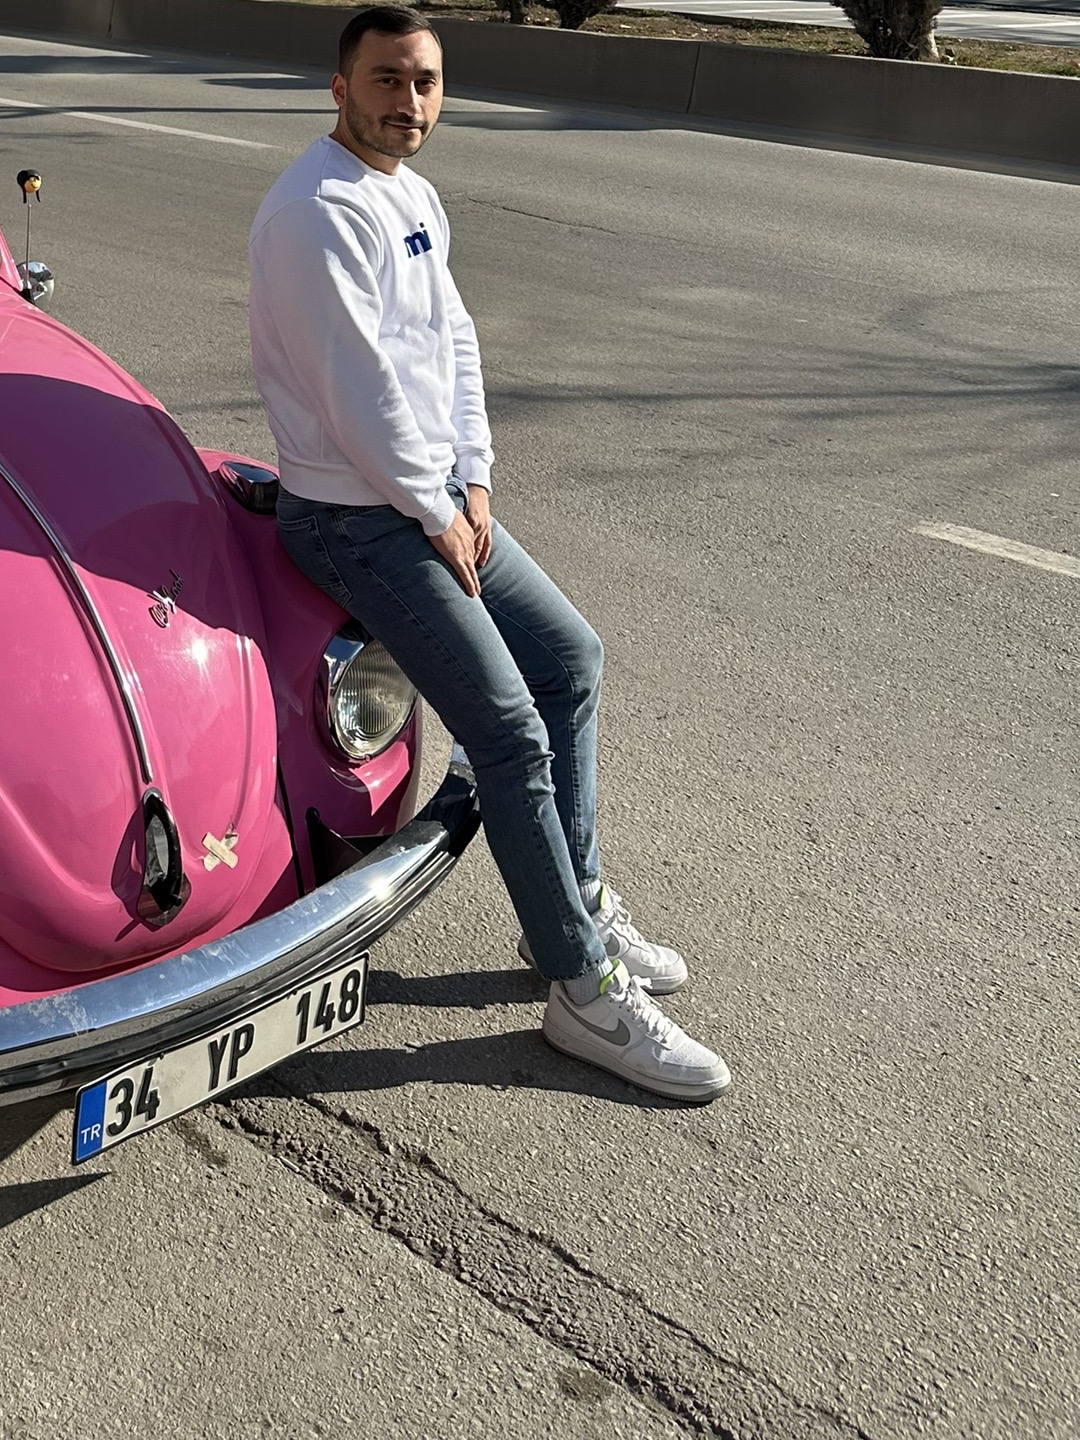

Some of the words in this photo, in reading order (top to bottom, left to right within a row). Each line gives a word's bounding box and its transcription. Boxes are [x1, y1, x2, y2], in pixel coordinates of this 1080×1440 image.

[81, 1123, 101, 1144] TR
[106, 1066, 161, 1138] 34
[208, 1023, 255, 1091] YP
[296, 969, 361, 1045] 148
